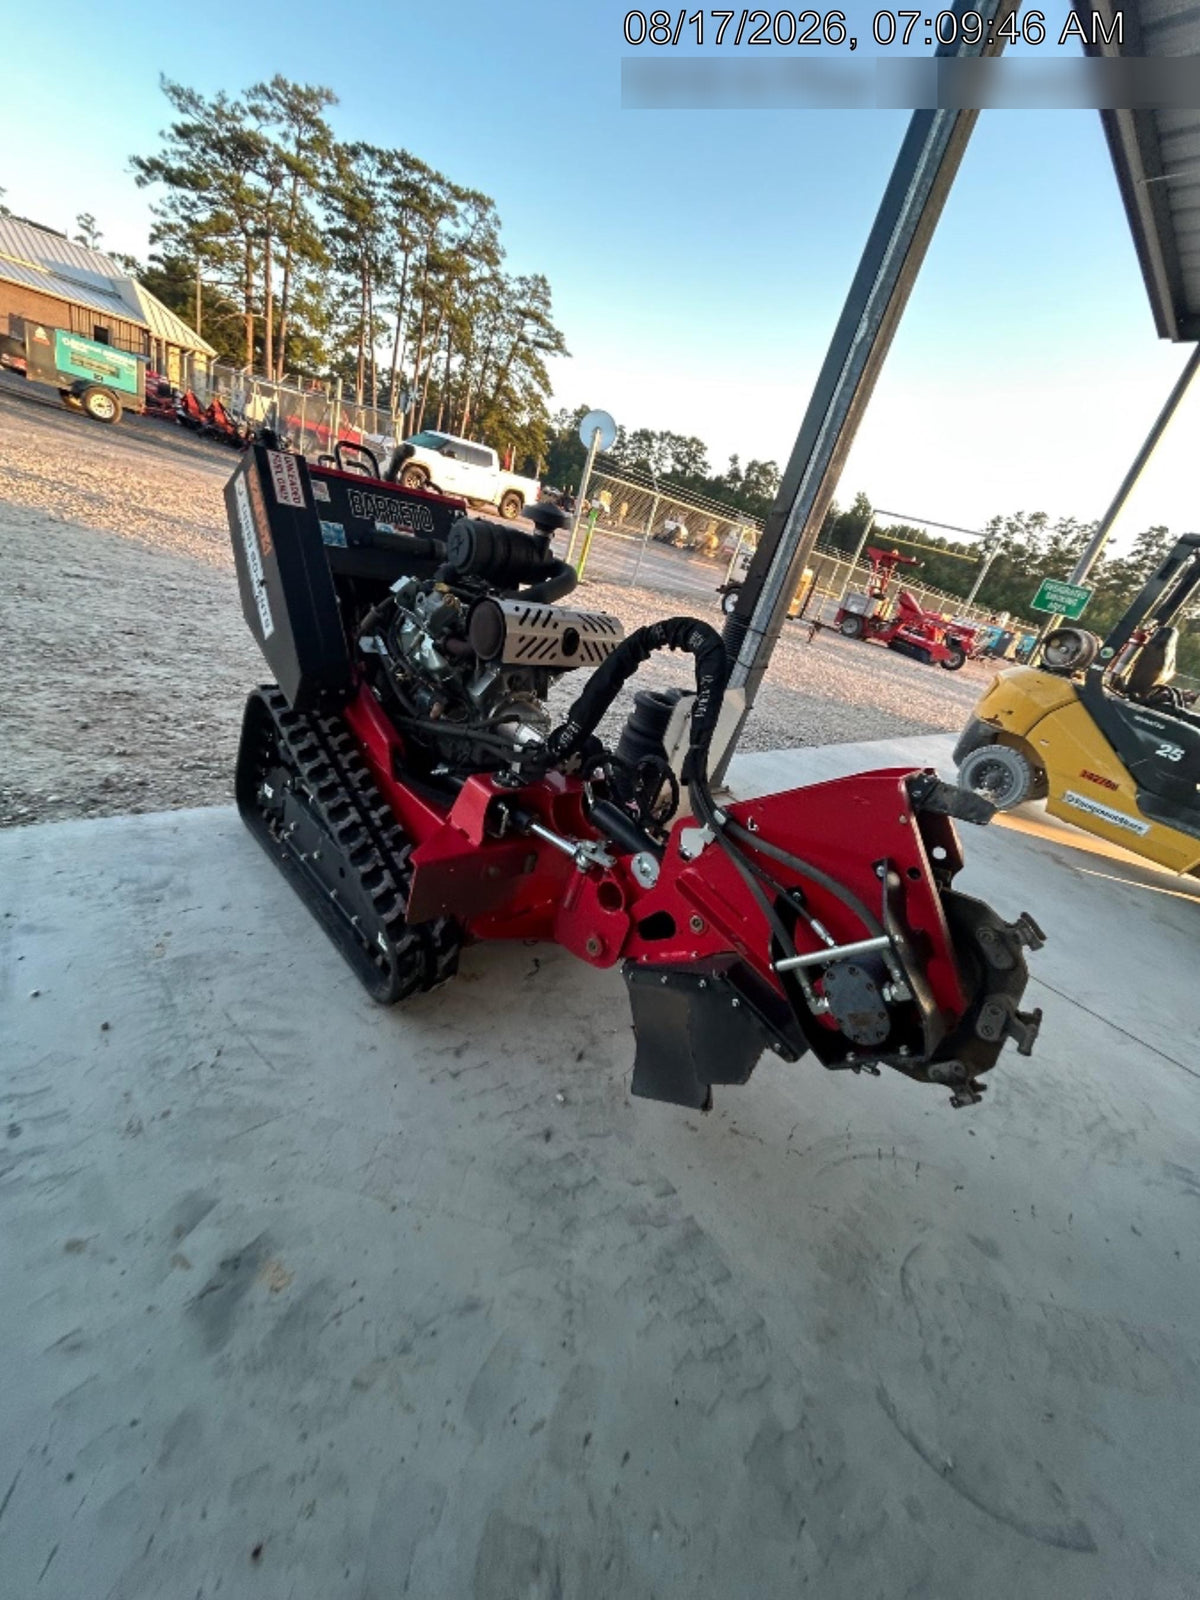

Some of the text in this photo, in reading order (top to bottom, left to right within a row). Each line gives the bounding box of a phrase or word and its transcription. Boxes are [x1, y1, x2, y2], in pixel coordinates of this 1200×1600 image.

[284, 455, 300, 504] UNLEADED
[347, 488, 434, 532] BARRETO
[1155, 743, 1186, 762] 25
